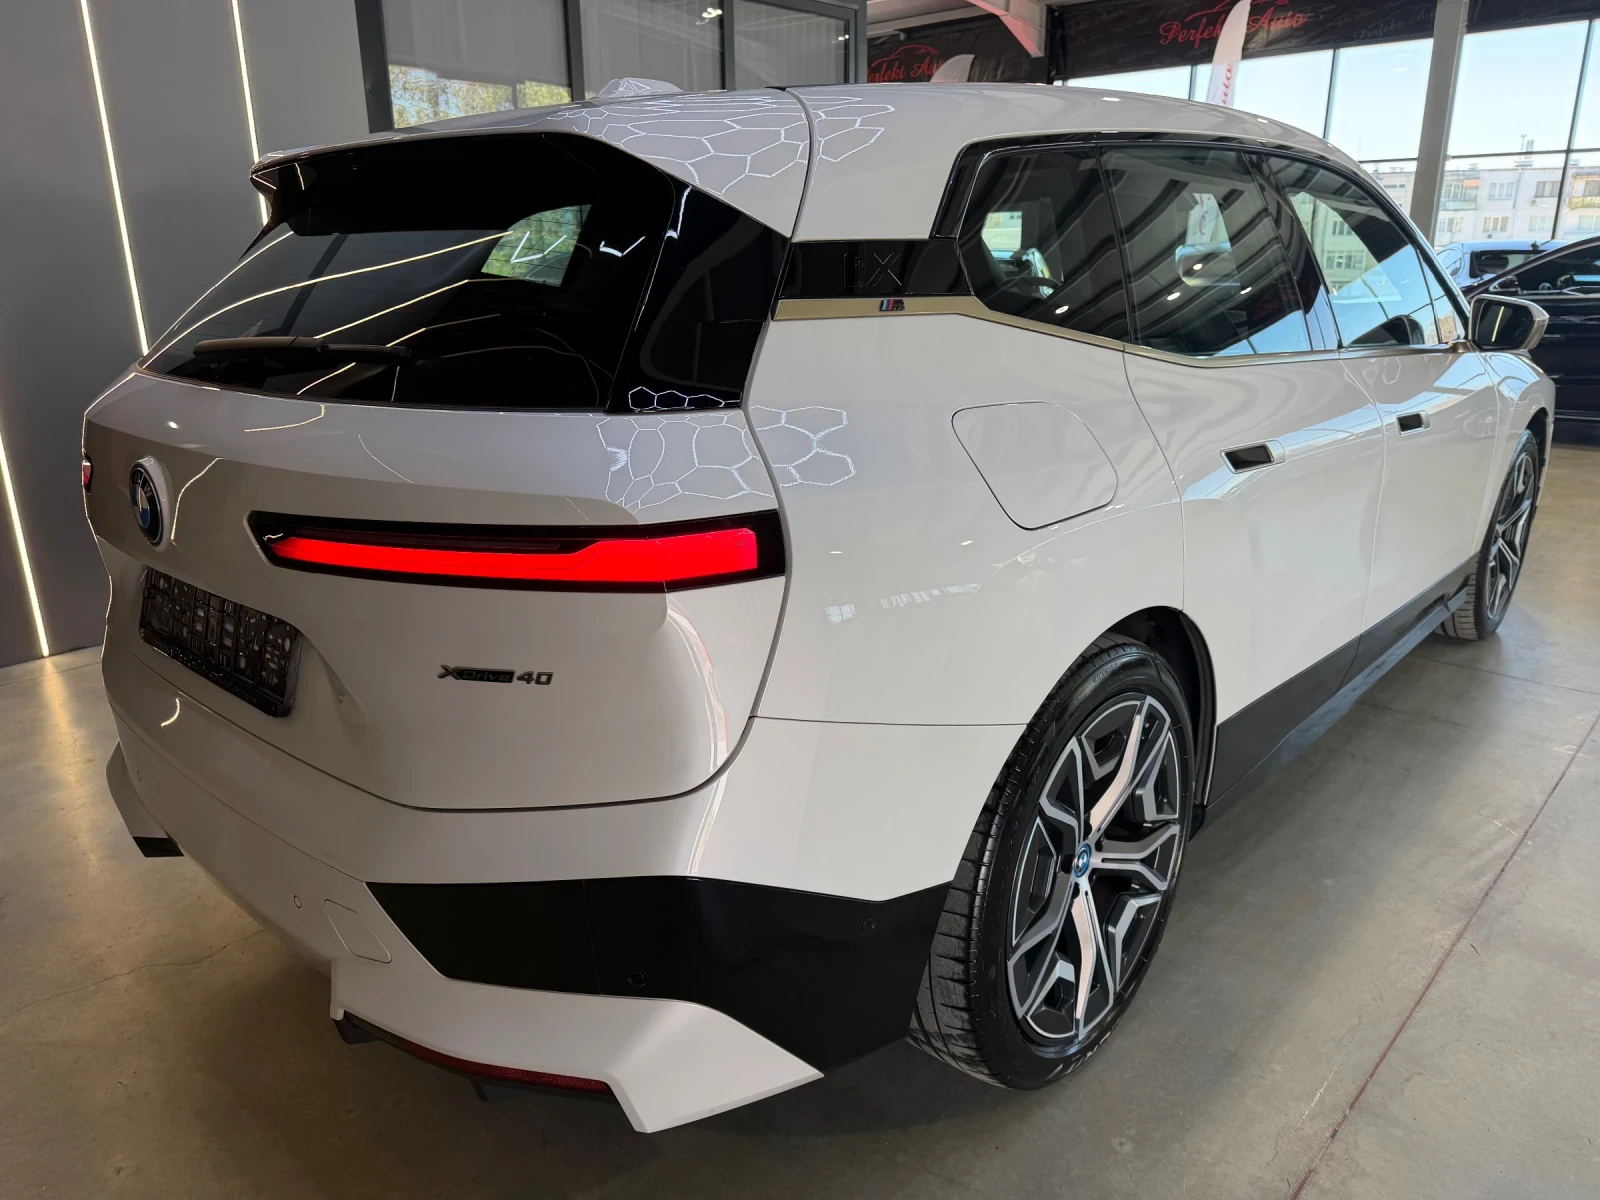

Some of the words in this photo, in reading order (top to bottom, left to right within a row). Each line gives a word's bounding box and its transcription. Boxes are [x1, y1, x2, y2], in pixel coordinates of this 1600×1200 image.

[1247, 7, 1307, 33] Auto
[867, 60, 905, 83] erfekt
[516, 670, 554, 686] 40
